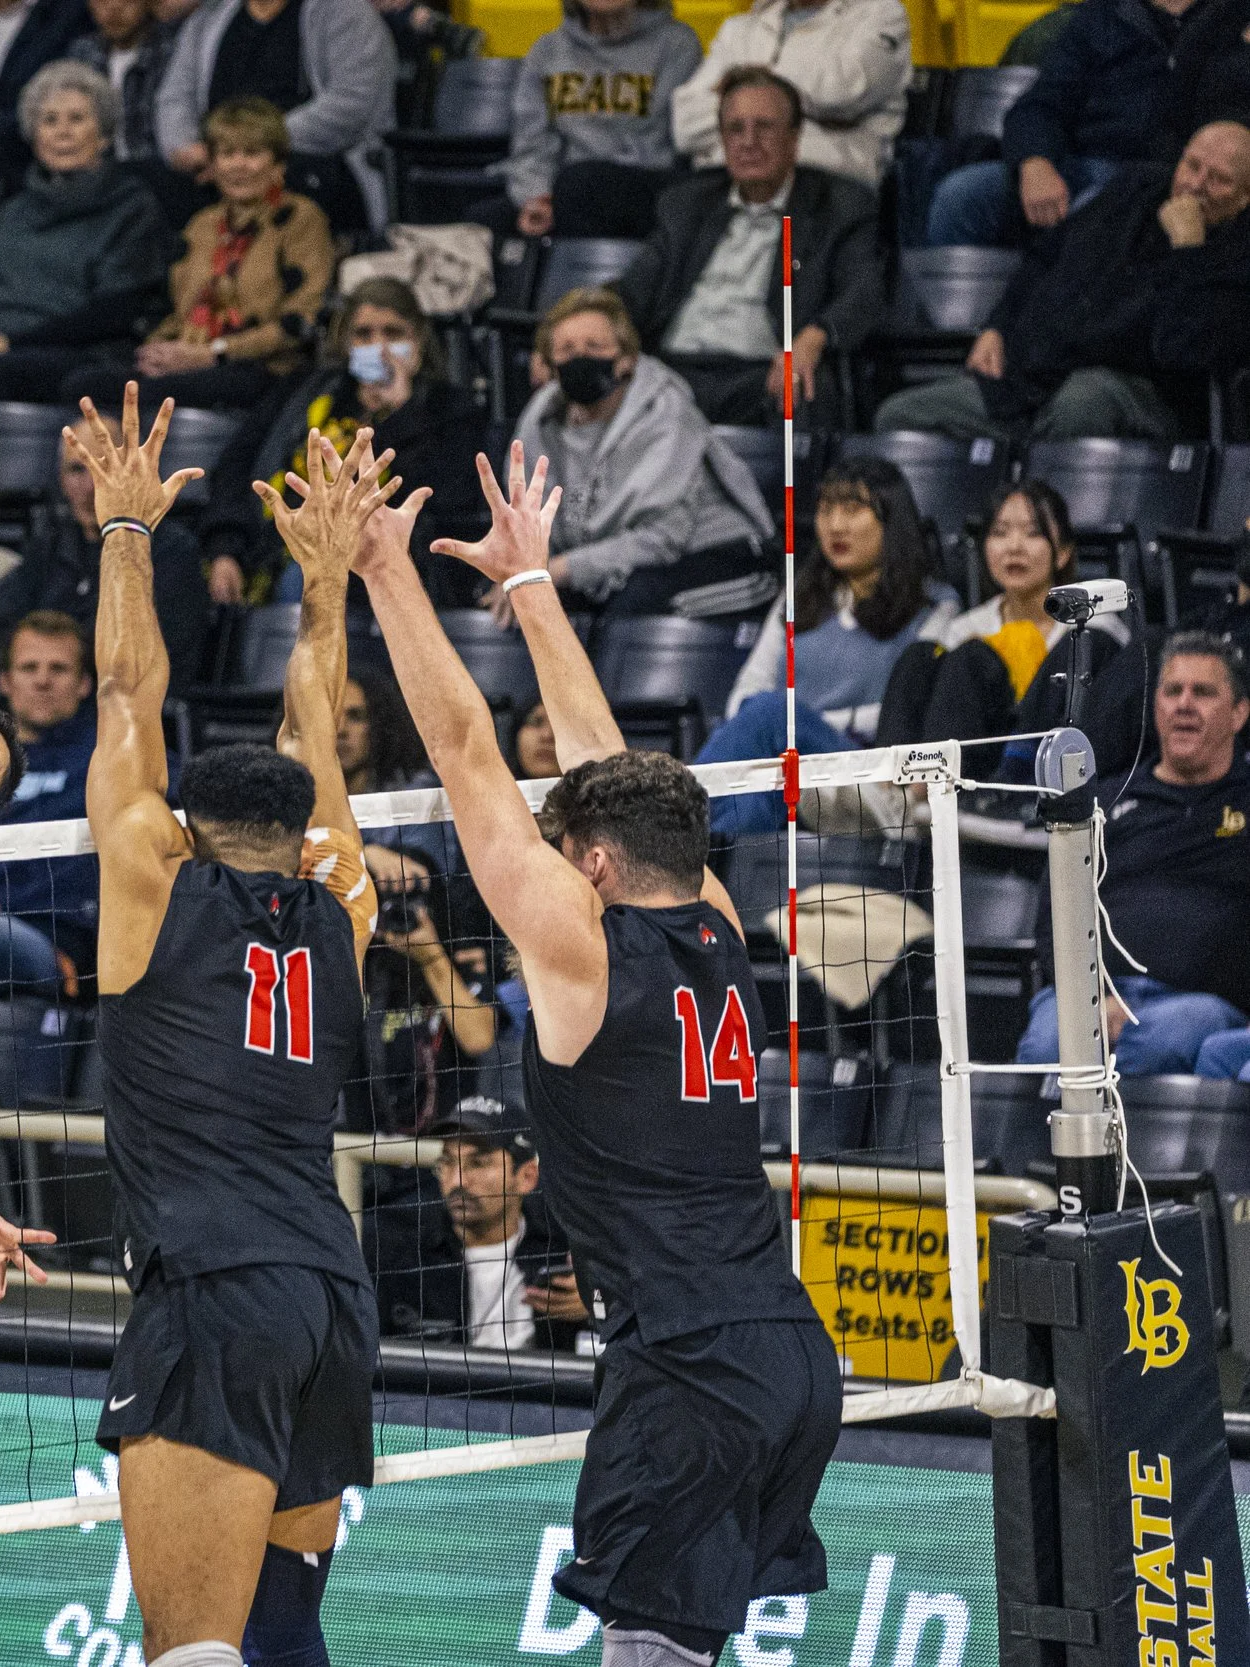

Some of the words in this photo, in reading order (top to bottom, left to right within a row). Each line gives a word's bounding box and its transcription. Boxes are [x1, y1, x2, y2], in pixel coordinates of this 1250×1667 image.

[916, 750, 943, 761] Senoh
[244, 942, 313, 1065] 11
[674, 984, 757, 1103] 14
[1059, 1185, 1082, 1215] S
[833, 1306, 922, 1342] Seats
[837, 1264, 935, 1300] ROWS
[1117, 1257, 1190, 1376] LB
[1128, 1449, 1180, 1667] STATE
[1184, 1556, 1216, 1667] ALL
